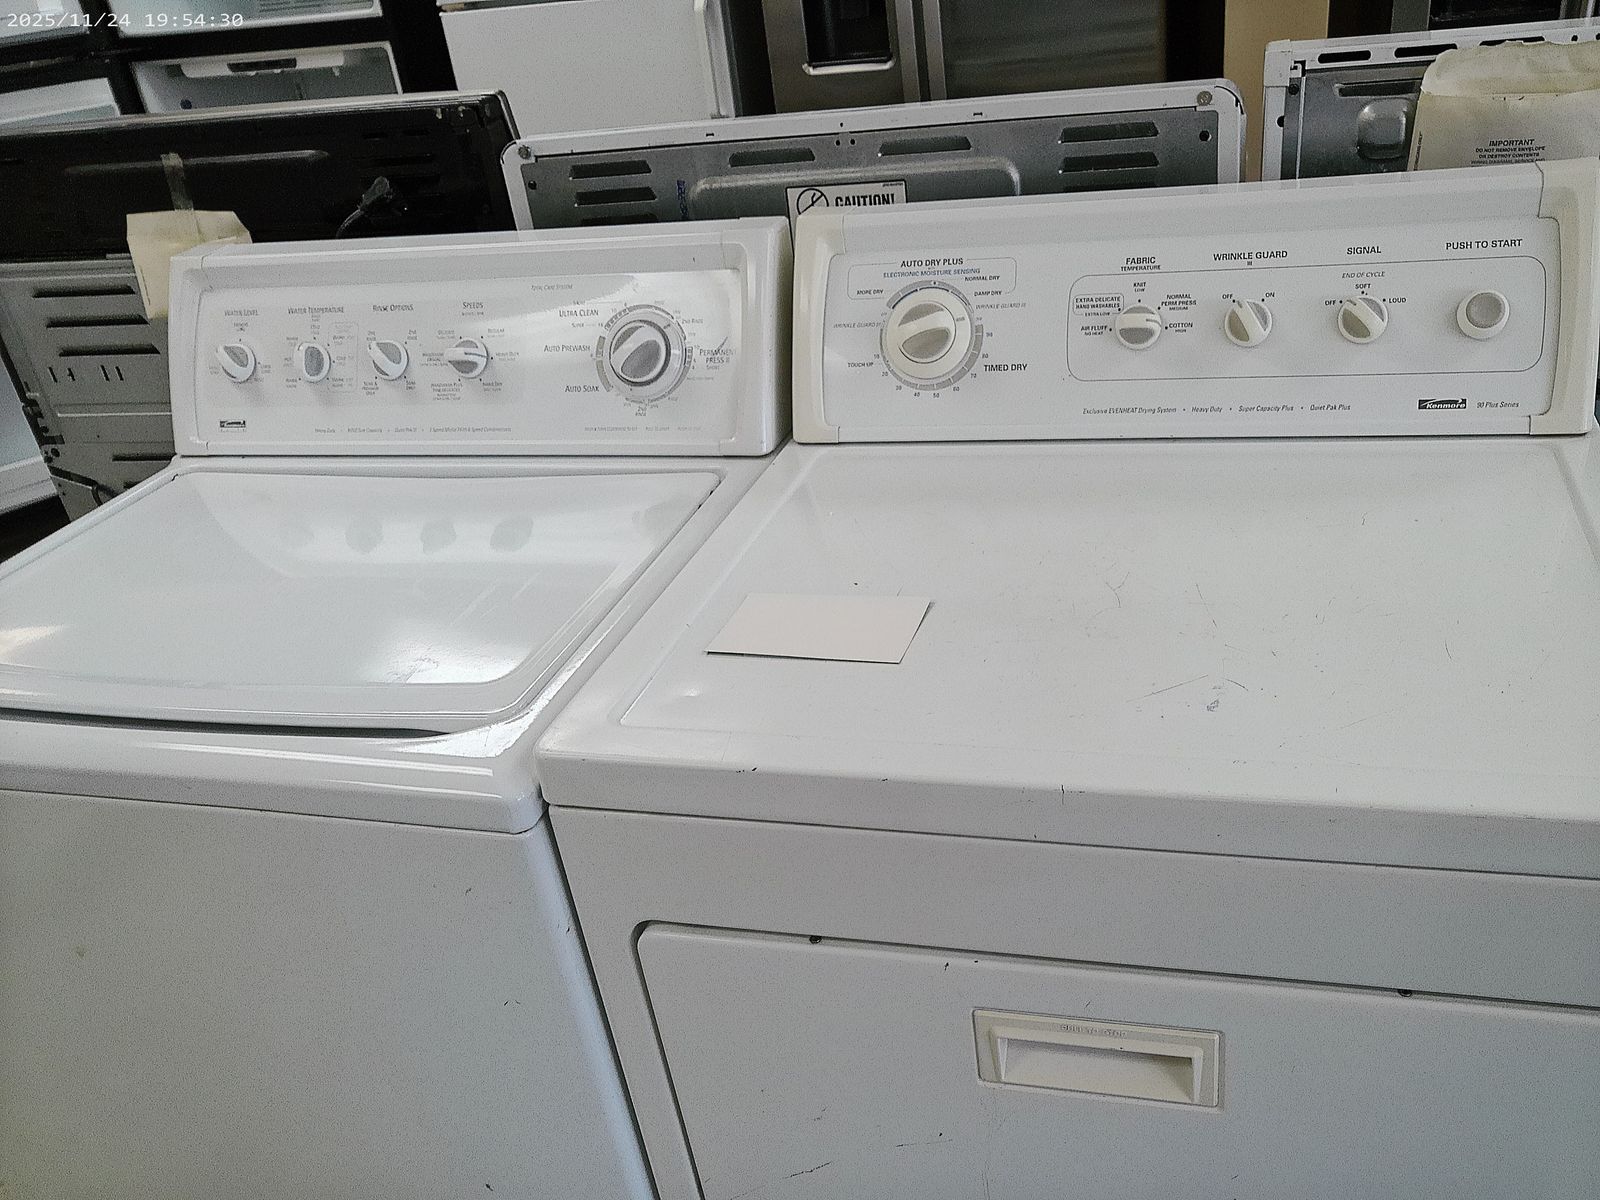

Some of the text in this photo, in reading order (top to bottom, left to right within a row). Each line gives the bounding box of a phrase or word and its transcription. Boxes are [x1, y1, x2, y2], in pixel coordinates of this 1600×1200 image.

[835, 193, 894, 207] CAUTION!
[1446, 239, 1523, 250] PUSH TO START
[1347, 246, 1382, 255] SIGNAL
[1213, 250, 1288, 262] WRINKLE GUARD
[901, 259, 923, 268] AUTO
[925, 259, 941, 267] DRY
[943, 258, 964, 266] PLUS
[1125, 257, 1156, 265] FABRIC
[884, 270, 919, 278] ELECTRONIC
[921, 269, 952, 277] MOISTURE
[1341, 271, 1356, 279] END
[308, 306, 344, 314] TEMPERATURE
[559, 309, 599, 318] ULTRA CLEAN
[543, 344, 591, 353] AUTO PREWASH
[984, 363, 1028, 372] TIMED DRY
[564, 384, 600, 393] AUTO SOAK
[1138, 407, 1156, 415] Drying
[1156, 406, 1177, 414] System
[1191, 406, 1208, 414] Heavy
[1256, 405, 1281, 413] Capacity
